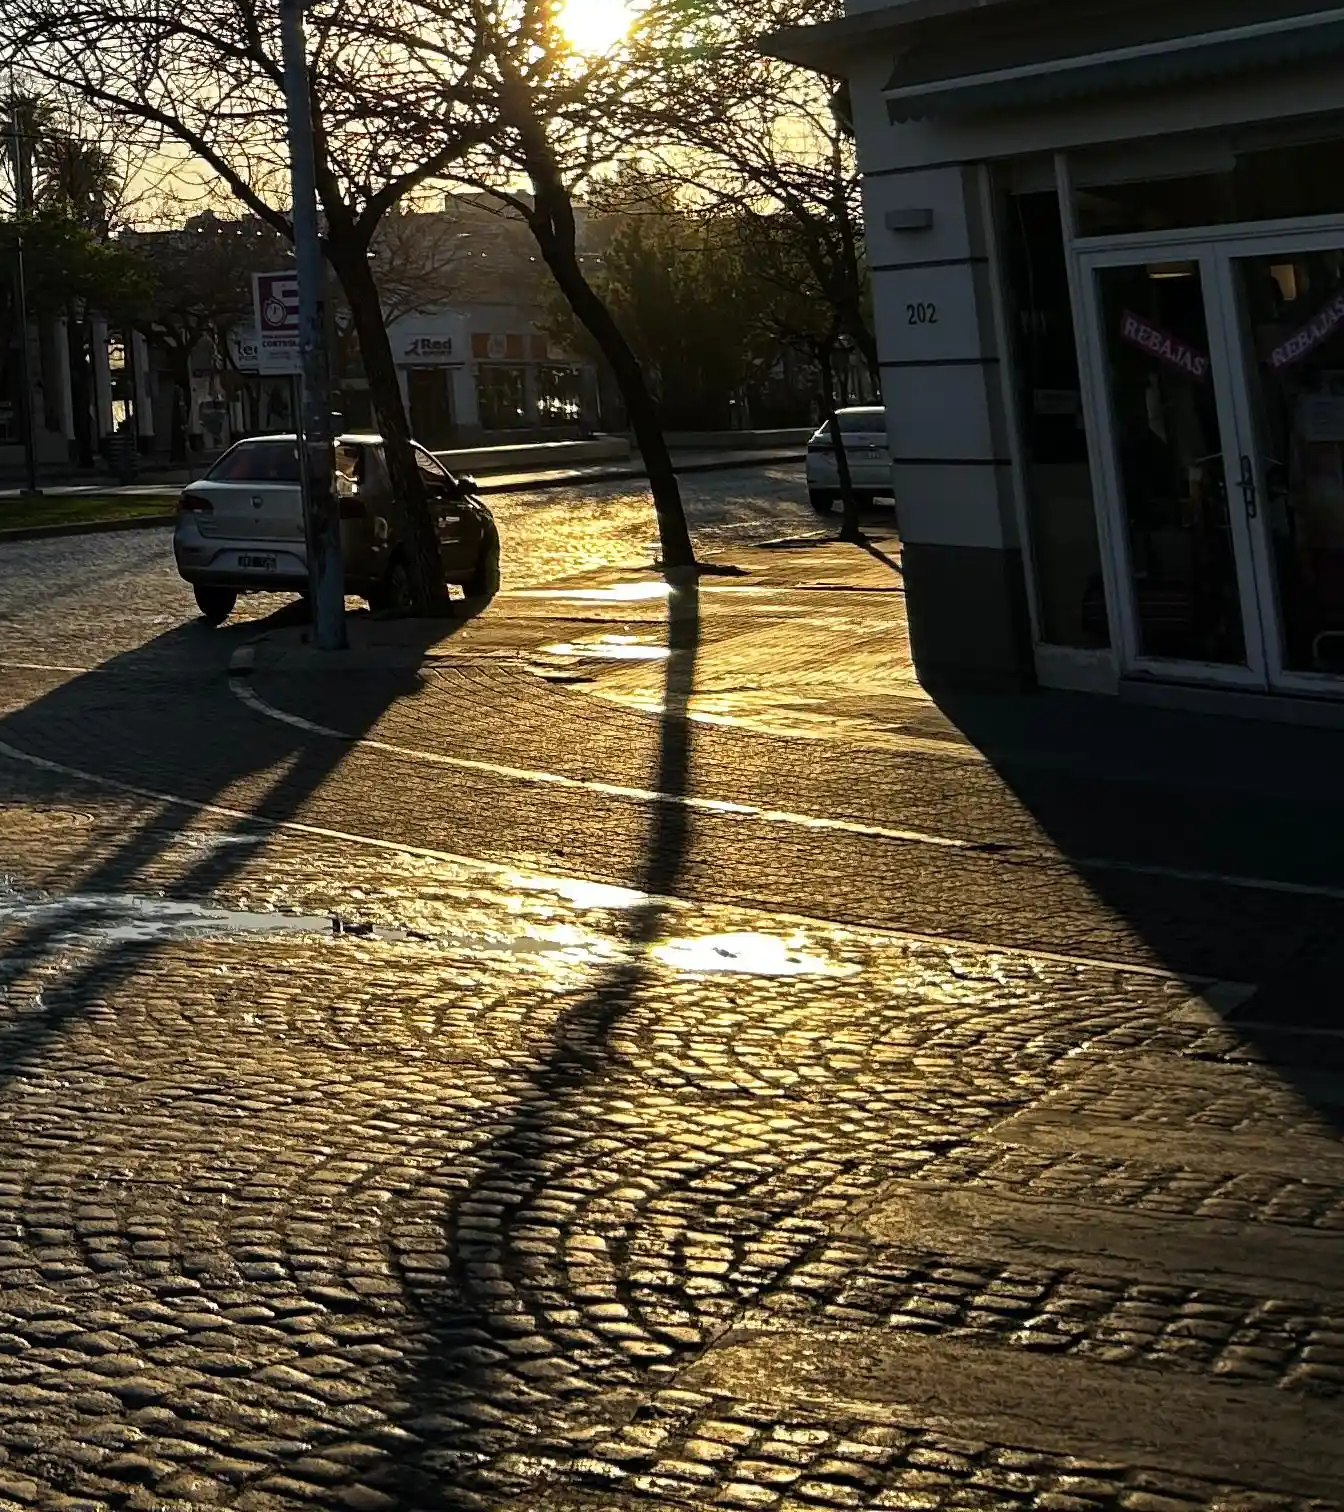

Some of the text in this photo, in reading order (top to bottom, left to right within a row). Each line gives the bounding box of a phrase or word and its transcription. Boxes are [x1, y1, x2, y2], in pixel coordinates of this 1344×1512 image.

[907, 303, 939, 325] 202
[421, 338, 452, 350] Red
[1123, 317, 1205, 376] REBAJAS
